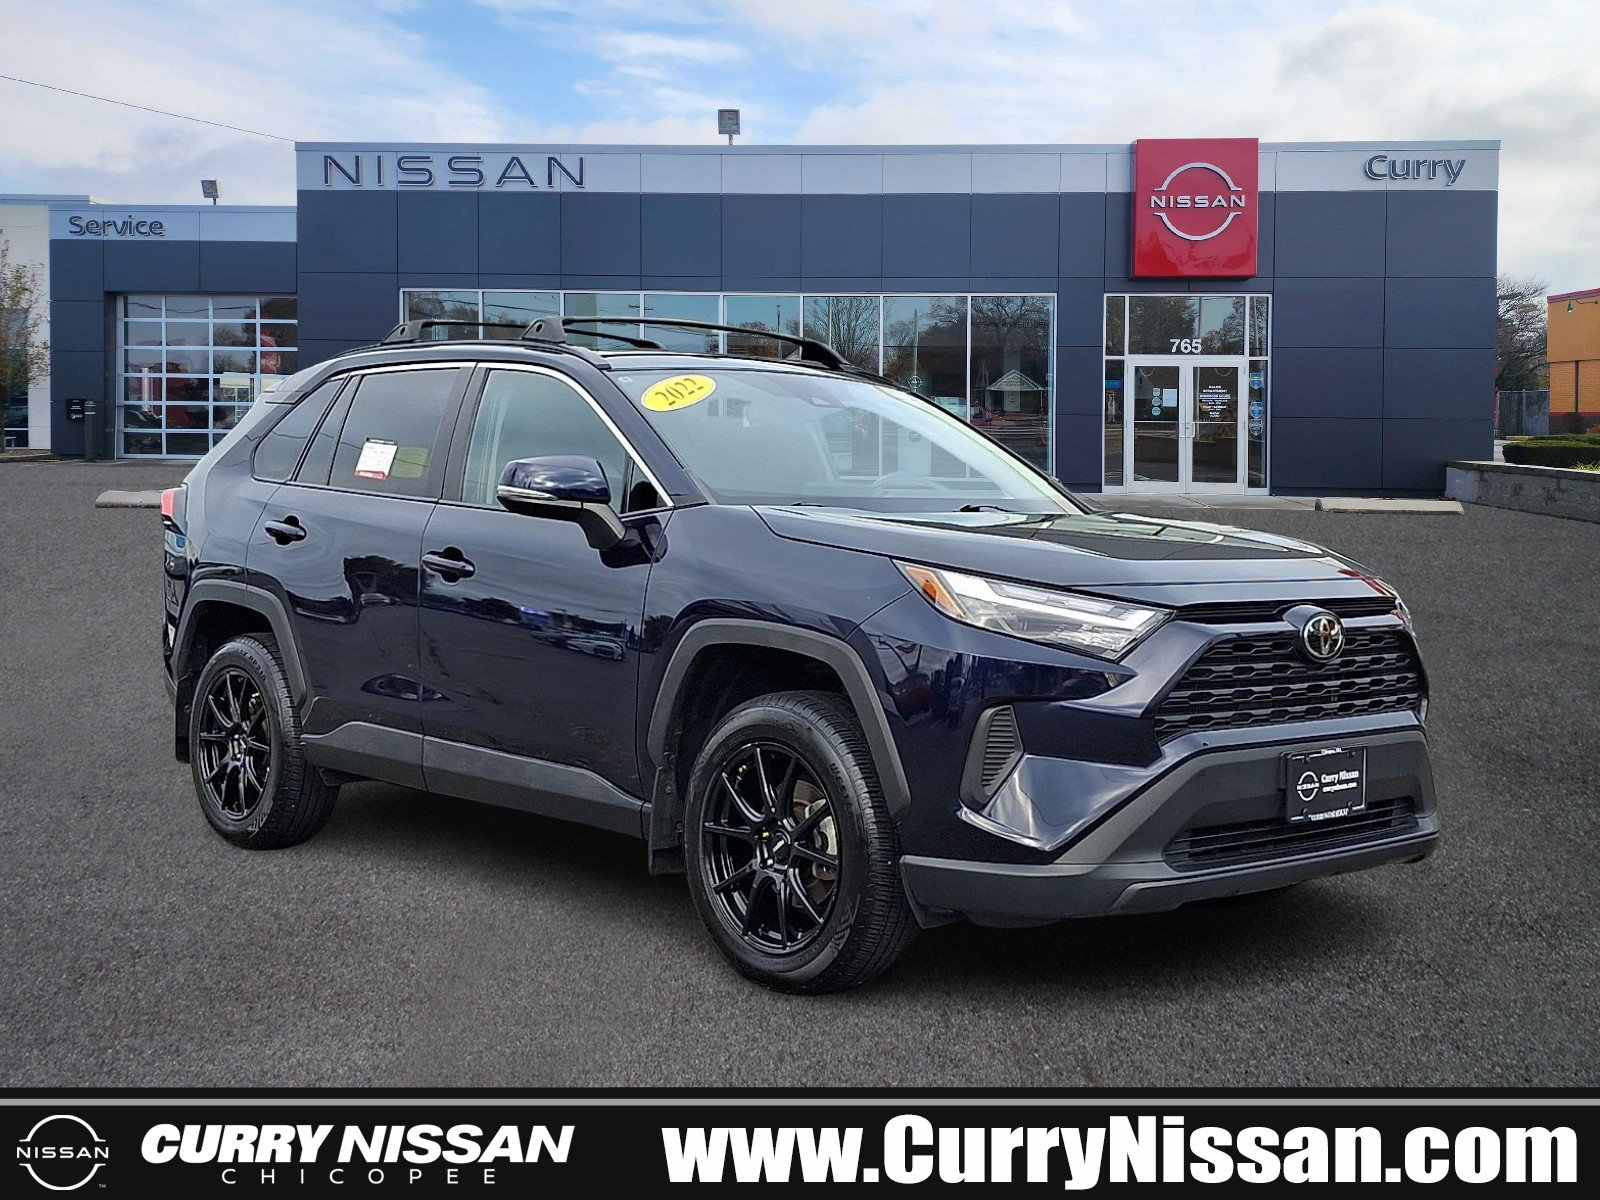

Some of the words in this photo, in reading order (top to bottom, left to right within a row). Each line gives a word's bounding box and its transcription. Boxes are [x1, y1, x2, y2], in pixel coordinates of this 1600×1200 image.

[323, 155, 585, 188] NISSAN
[1363, 155, 1466, 187] Curry
[1150, 194, 1245, 208] NISSAN
[69, 214, 165, 236] Service
[1169, 338, 1202, 354] 765
[654, 377, 704, 406] 2022
